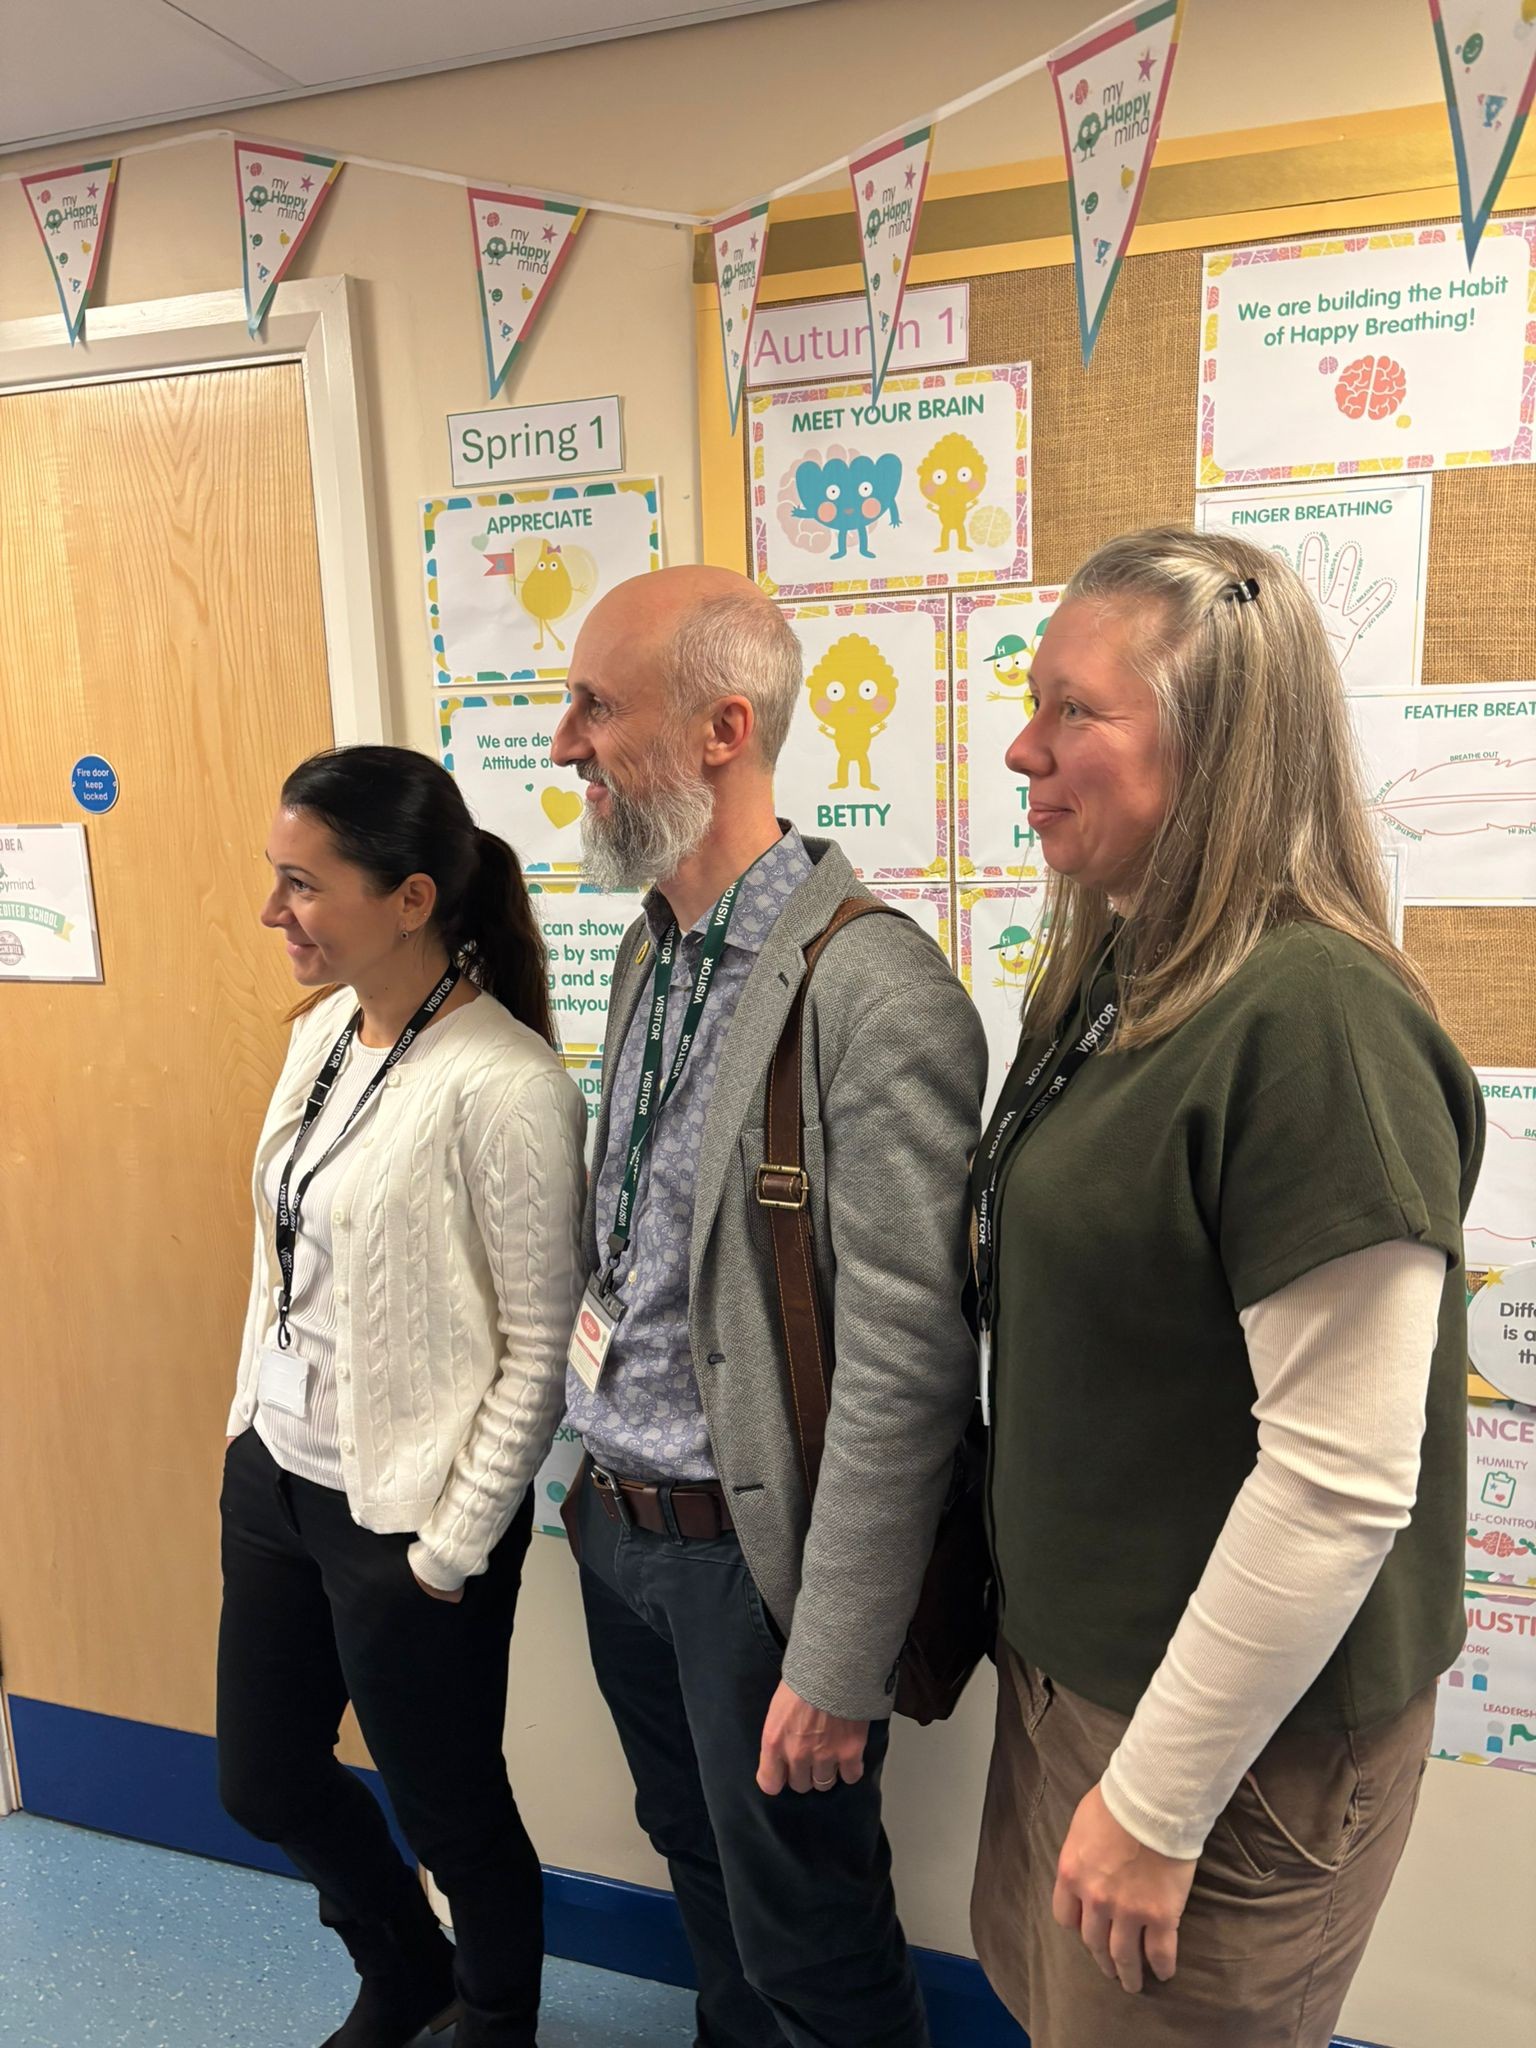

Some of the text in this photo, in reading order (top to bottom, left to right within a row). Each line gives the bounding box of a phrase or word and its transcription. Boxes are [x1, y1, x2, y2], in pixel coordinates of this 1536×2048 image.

[1102, 81, 1124, 101] my
[1103, 92, 1151, 126] Happy
[1114, 115, 1150, 147] mind
[272, 178, 289, 192] my
[883, 187, 896, 204] my
[62, 195, 77, 207] my
[64, 203, 97, 219] Happy
[271, 193, 308, 210] Happy
[882, 198, 912, 223] Happy
[73, 216, 98, 230] mind
[277, 206, 305, 221] mind
[511, 228, 529, 243] my
[888, 217, 911, 240] mind
[510, 242, 550, 260] Happy
[517, 258, 549, 275] mind
[1237, 276, 1509, 321] We are building the Habit
[938, 307, 953, 345] 1
[1264, 308, 1475, 347] of Happy Breathing!
[792, 394, 984, 432] MEET YOUR BRAIN
[462, 415, 604, 469] Spring 1
[487, 508, 593, 535] APPRECIATE
[1232, 499, 1393, 525] FINGER BREATHING
[1404, 701, 1536, 720] FEATHER BREAT
[477, 735, 500, 749] We
[504, 736, 527, 748] are
[482, 755, 536, 770] Attitude
[1450, 751, 1499, 762] BREATHE OUT
[77, 768, 109, 777] Fire door
[83, 792, 108, 800] locked
[85, 780, 103, 790] keep
[817, 804, 891, 827] BETTY
[28, 906, 58, 928] SCHOOL
[543, 919, 624, 936] can show
[564, 944, 585, 965] by
[561, 969, 594, 986] and
[693, 957, 714, 1004] VISITOR
[424, 977, 454, 1013] VISITOR
[651, 995, 665, 1040] VISITOR
[1075, 1003, 1118, 1053] VISITOR
[329, 1029, 352, 1069] VISITOR
[386, 1028, 416, 1067] VISITOR
[672, 1034, 692, 1079] VISITOR
[1025, 1039, 1059, 1087] VISITOR
[638, 1070, 654, 1116] VISITOR
[1026, 1075, 1067, 1120] VISITOR
[988, 1110, 1017, 1161] VISITOR
[280, 1183, 288, 1226] VISITOR
[618, 1190, 630, 1227] VISITOR
[978, 1189, 988, 1245] VISITOR
[1500, 1302, 1536, 1318] Diff
[1503, 1324, 1518, 1340] is
[1476, 1456, 1528, 1470] HUMILTY
